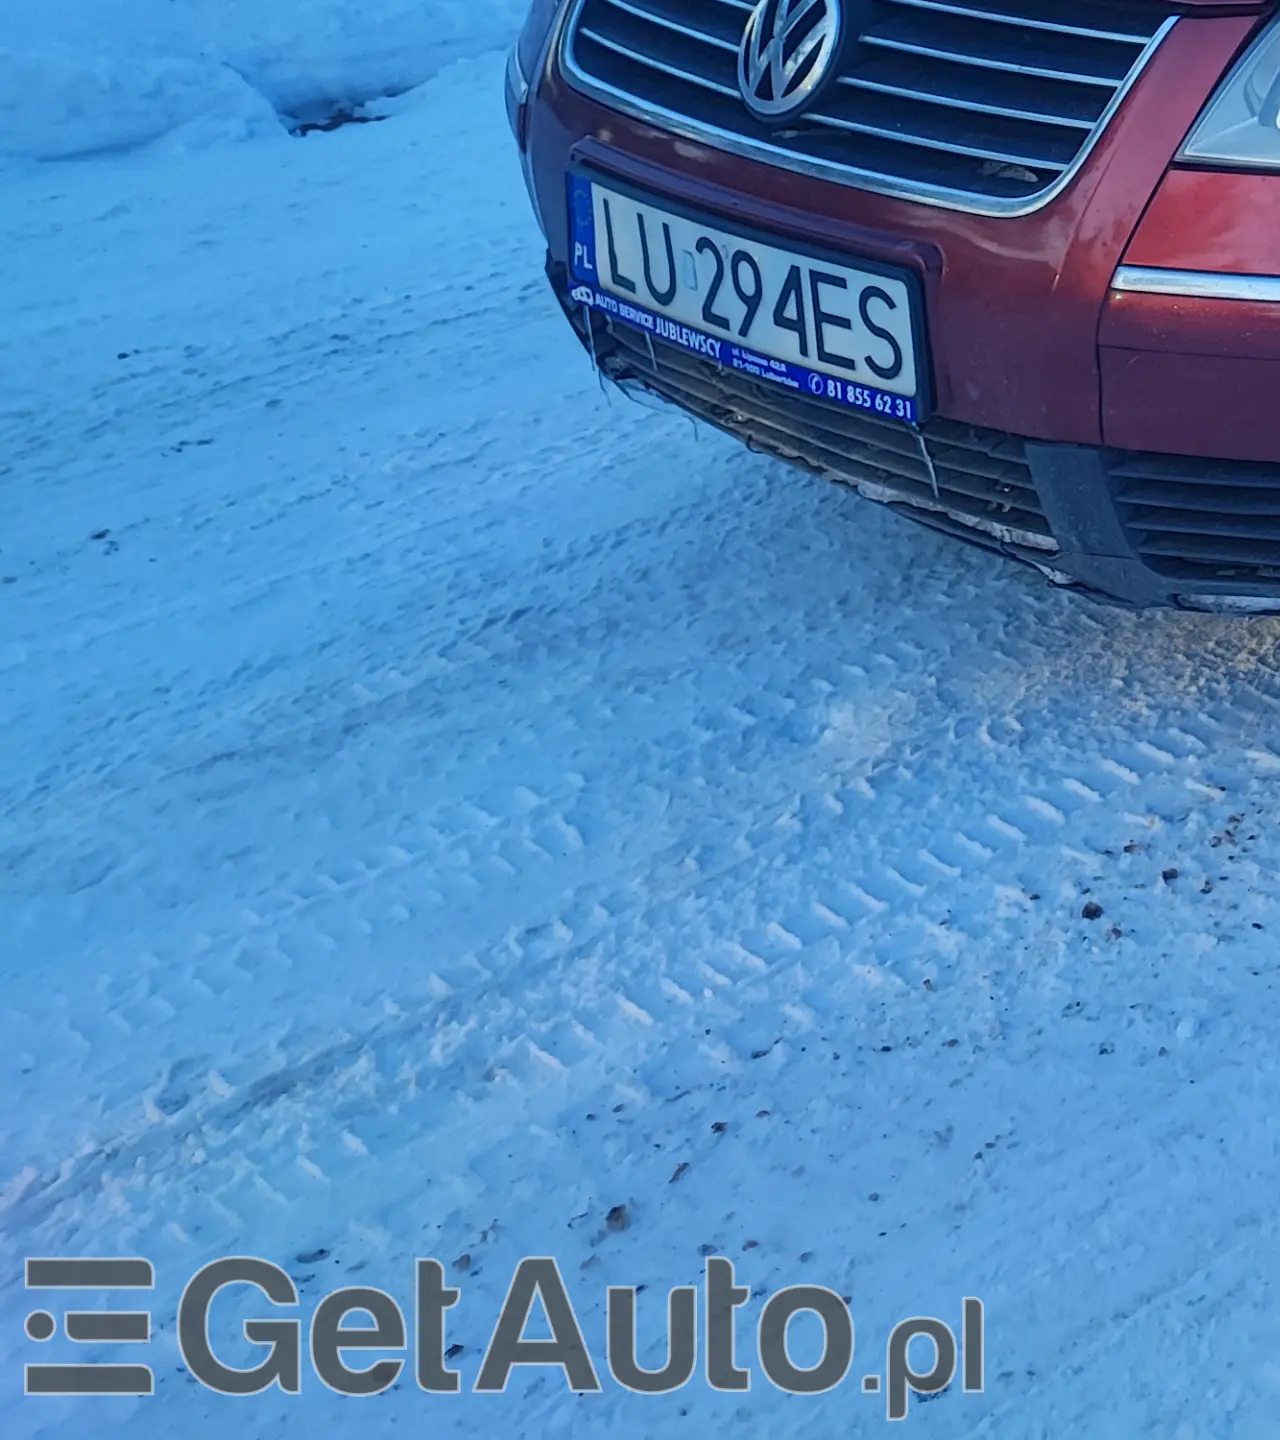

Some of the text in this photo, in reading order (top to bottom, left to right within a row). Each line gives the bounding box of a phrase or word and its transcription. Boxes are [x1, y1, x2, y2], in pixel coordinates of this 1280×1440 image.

[574, 241, 593, 270] PL
[602, 198, 903, 380] LU 294ES
[595, 294, 618, 313] AUTO
[619, 304, 655, 330] SERVICE
[826, 379, 912, 419] 81 855 62 31
